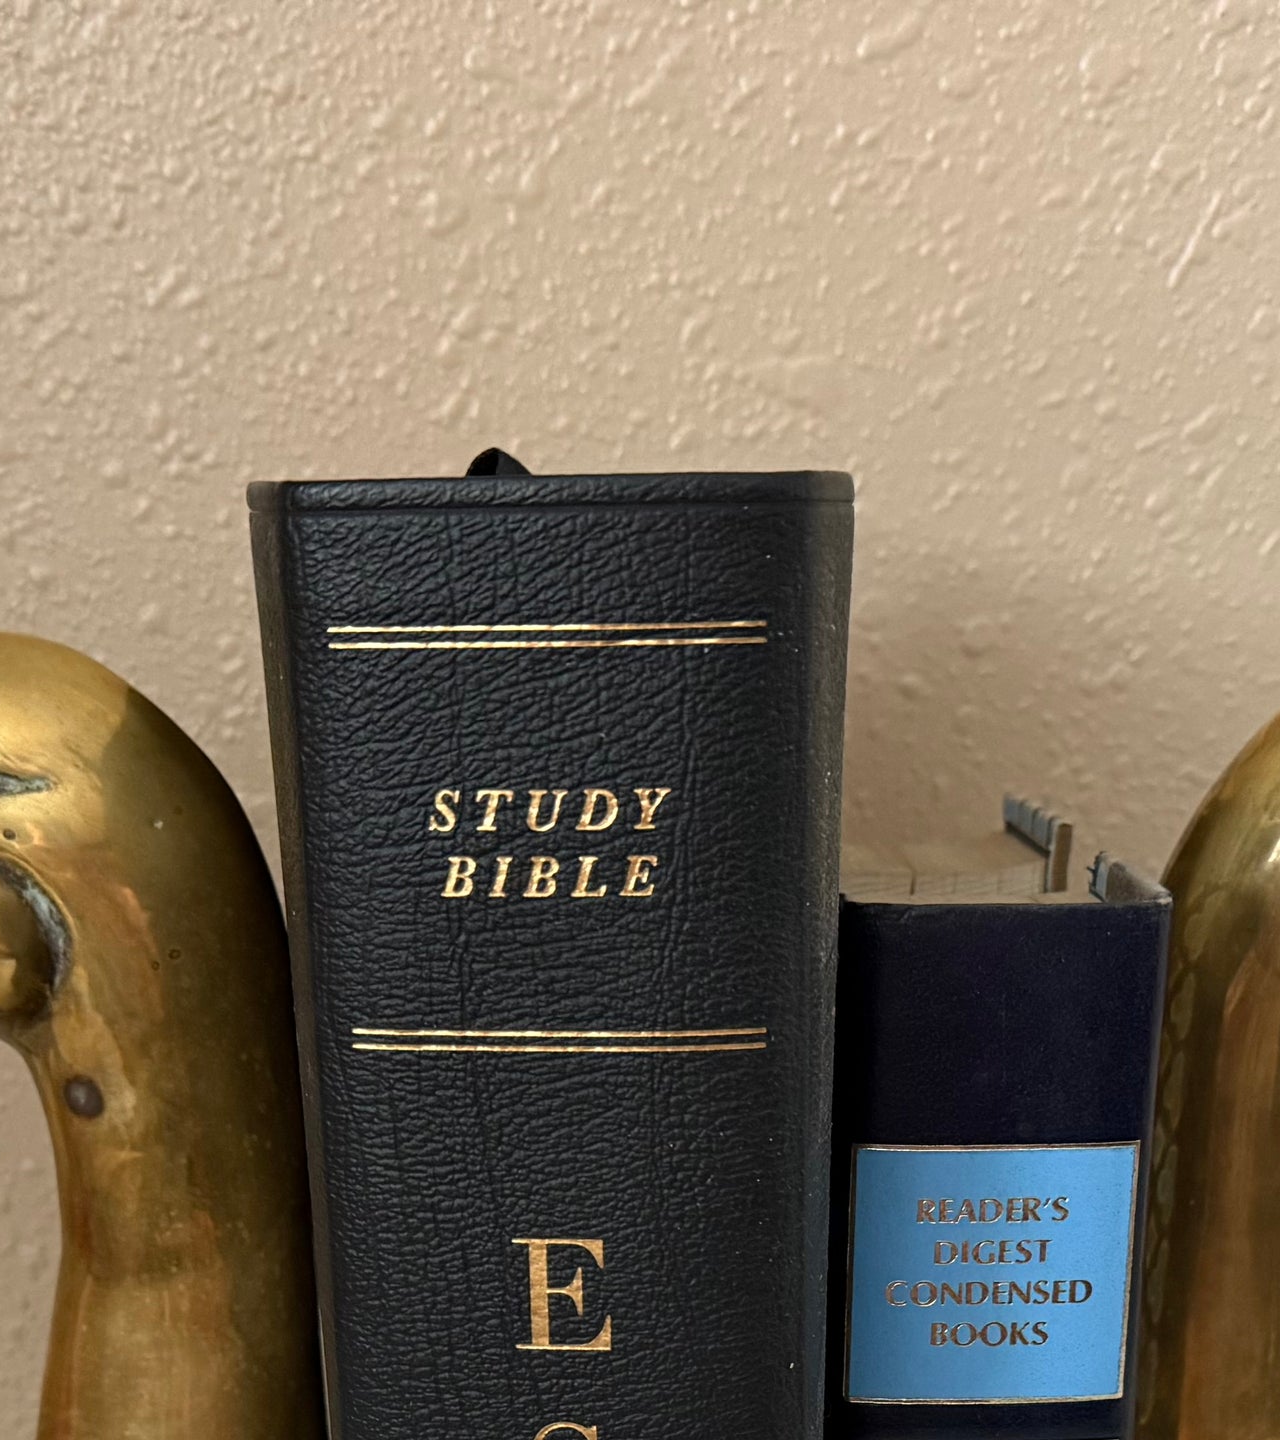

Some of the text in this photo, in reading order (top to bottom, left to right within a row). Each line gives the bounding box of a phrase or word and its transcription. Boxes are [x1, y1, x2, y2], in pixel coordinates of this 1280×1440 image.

[428, 787, 672, 832] STUDY
[440, 855, 659, 898] BIBLE
[915, 1196, 1070, 1225] READER'S
[933, 1239, 1053, 1266] DIGEST
[884, 1279, 1093, 1308] CONDENSED
[929, 1321, 1049, 1347] BOOKS
